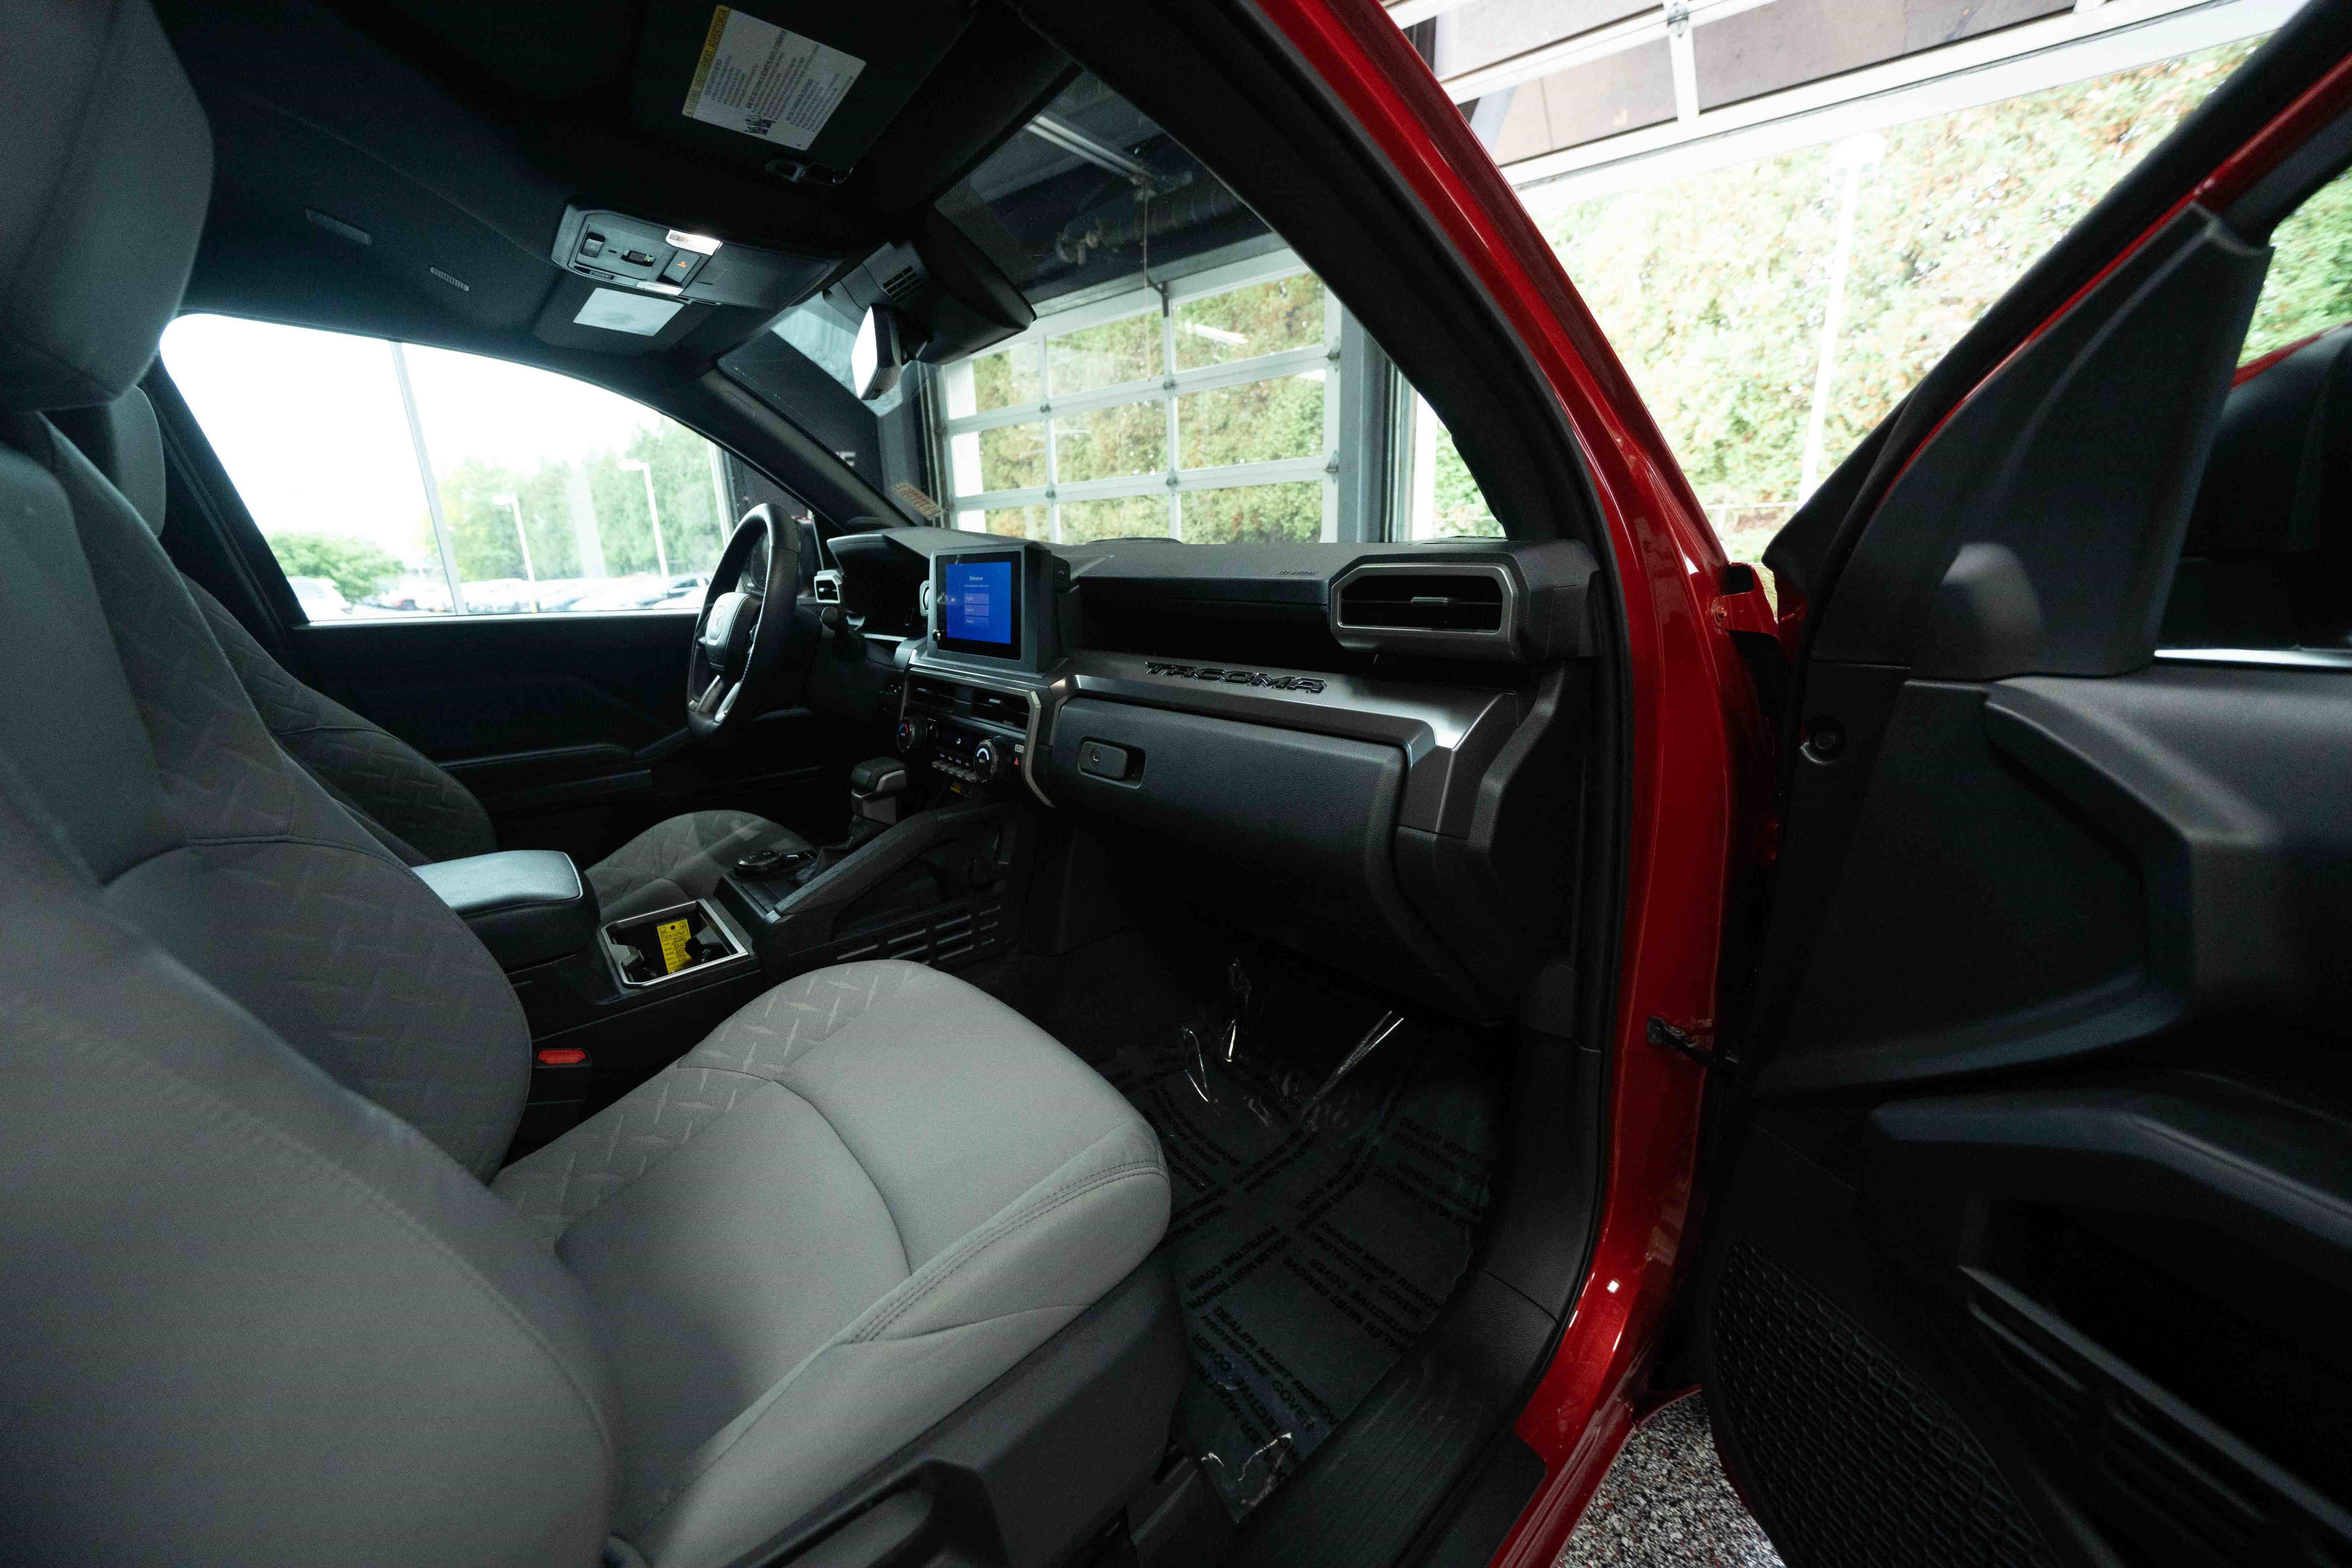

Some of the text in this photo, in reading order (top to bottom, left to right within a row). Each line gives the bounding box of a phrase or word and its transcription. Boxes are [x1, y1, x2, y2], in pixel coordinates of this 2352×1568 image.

[1145, 661, 1327, 695] TACOMA
[1397, 1278, 1439, 1310] REMOV
[1292, 1380, 1341, 1425] REMOV
